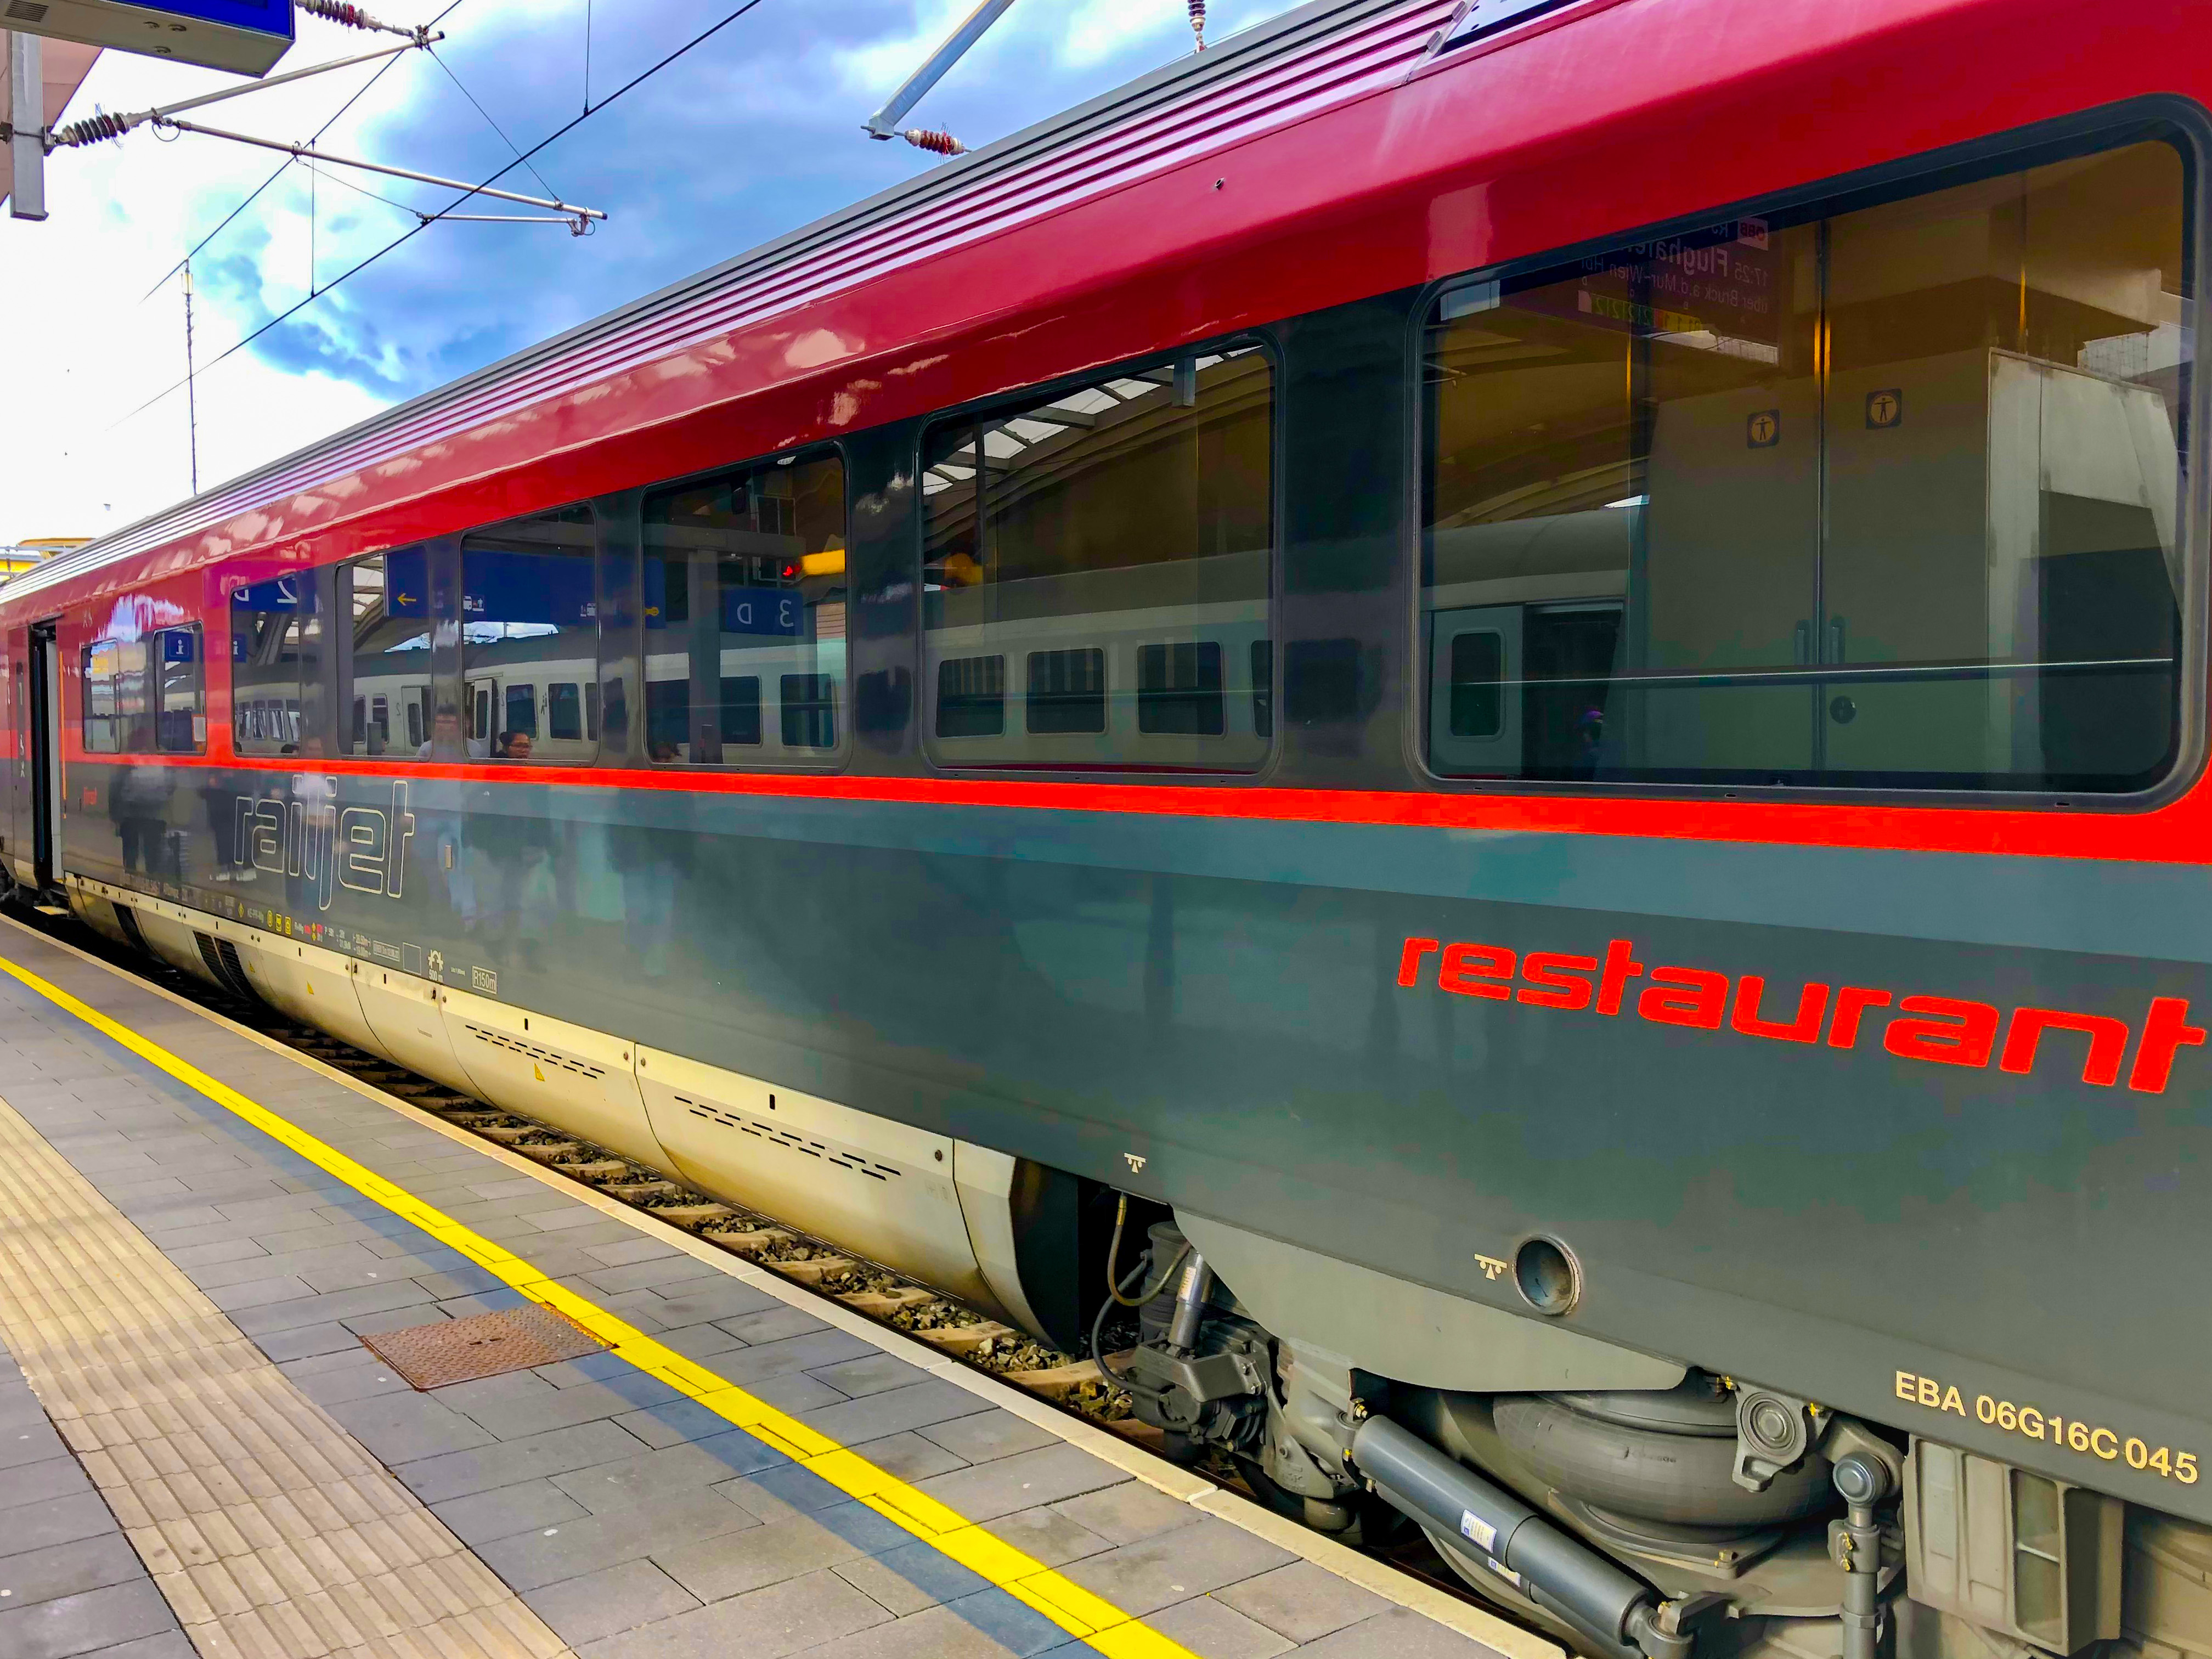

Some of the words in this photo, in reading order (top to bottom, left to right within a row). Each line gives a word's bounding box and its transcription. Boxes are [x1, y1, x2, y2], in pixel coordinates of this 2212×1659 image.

[234, 774, 415, 911] railjet
[428, 969, 437, 981] 500
[474, 970, 496, 990] R150m
[1397, 937, 2208, 1094] restaurant
[1895, 1370, 1966, 1417] EBA
[1976, 1395, 2119, 1460] 06G16C
[2125, 1437, 2198, 1485] 045
